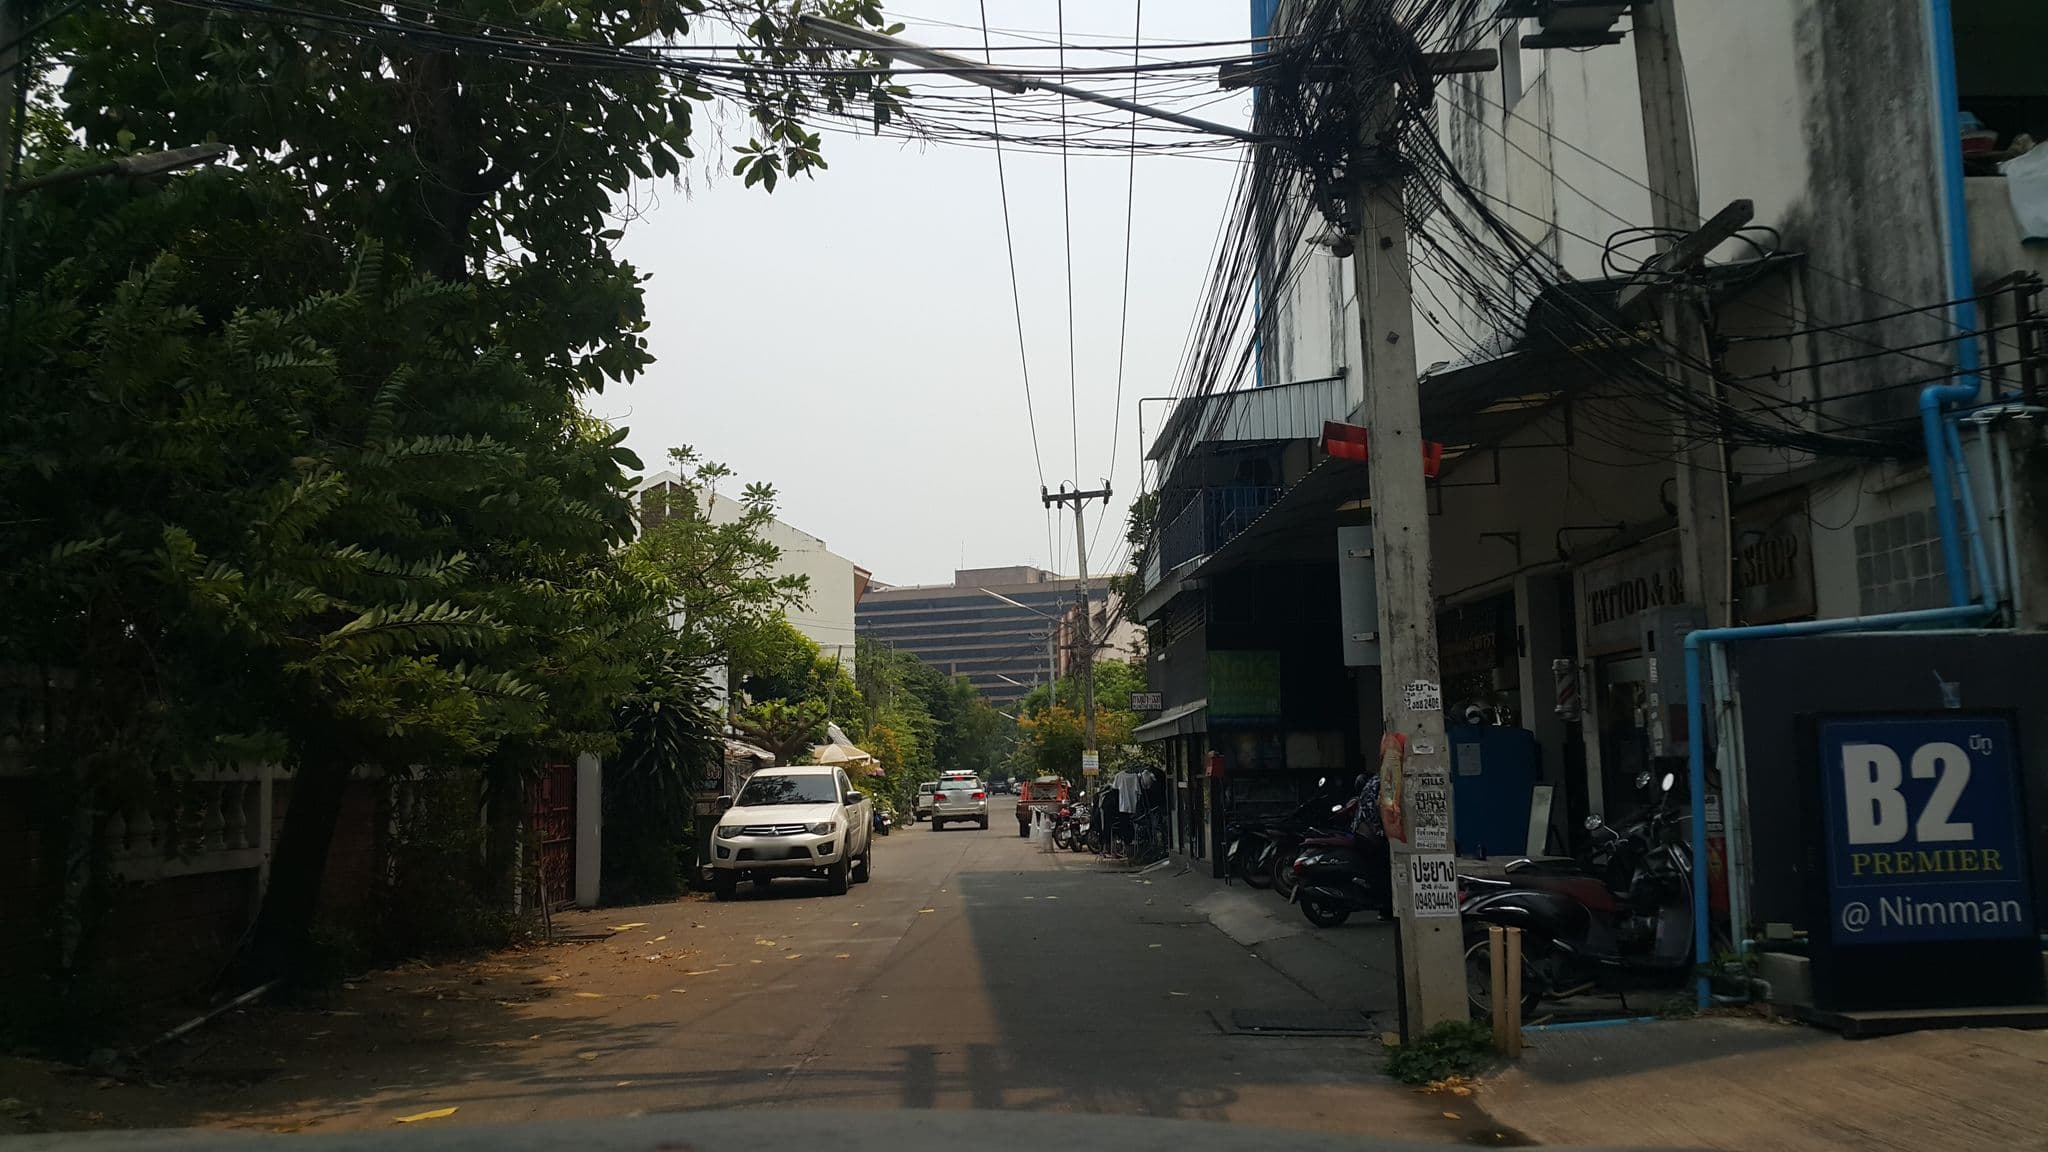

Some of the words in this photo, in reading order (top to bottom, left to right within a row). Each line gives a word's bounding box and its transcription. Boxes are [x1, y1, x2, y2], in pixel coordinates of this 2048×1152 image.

[1651, 573, 1665, 606] &
[1744, 535, 1797, 587] SHOP
[1842, 741, 1975, 845] B2
[1413, 856, 1455, 882] ปะยาง
[1852, 849, 2004, 876] PREMIER
[1842, 902, 1870, 932] @
[1880, 896, 2022, 926] Nimman
